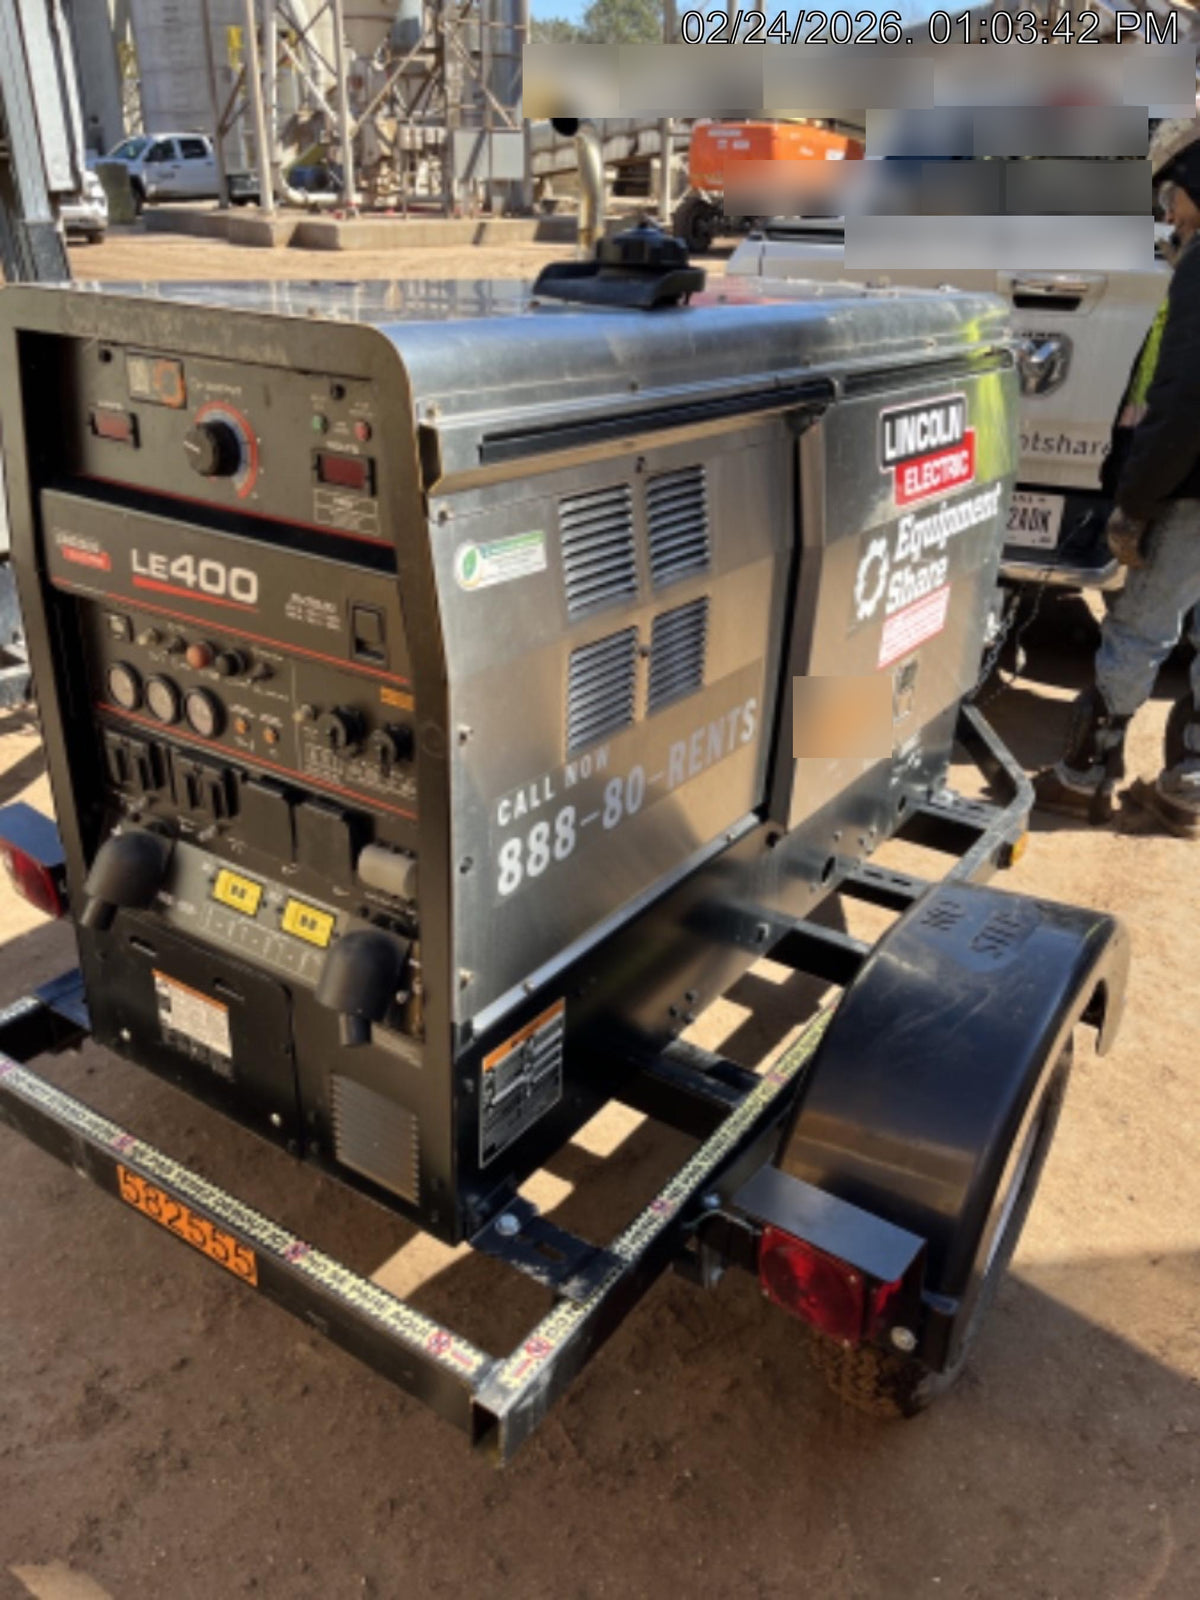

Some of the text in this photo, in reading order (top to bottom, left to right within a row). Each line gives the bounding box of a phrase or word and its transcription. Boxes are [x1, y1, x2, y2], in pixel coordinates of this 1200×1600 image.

[884, 403, 963, 461] LINCOLN
[904, 449, 970, 497] ELECTRIC
[894, 481, 1001, 562] Equipment
[130, 547, 259, 605] LE400
[885, 556, 949, 615] Share
[497, 747, 611, 827] CALL NOW
[497, 697, 758, 897] 888-80-RENTS
[121, 1168, 253, 1278] 582555
